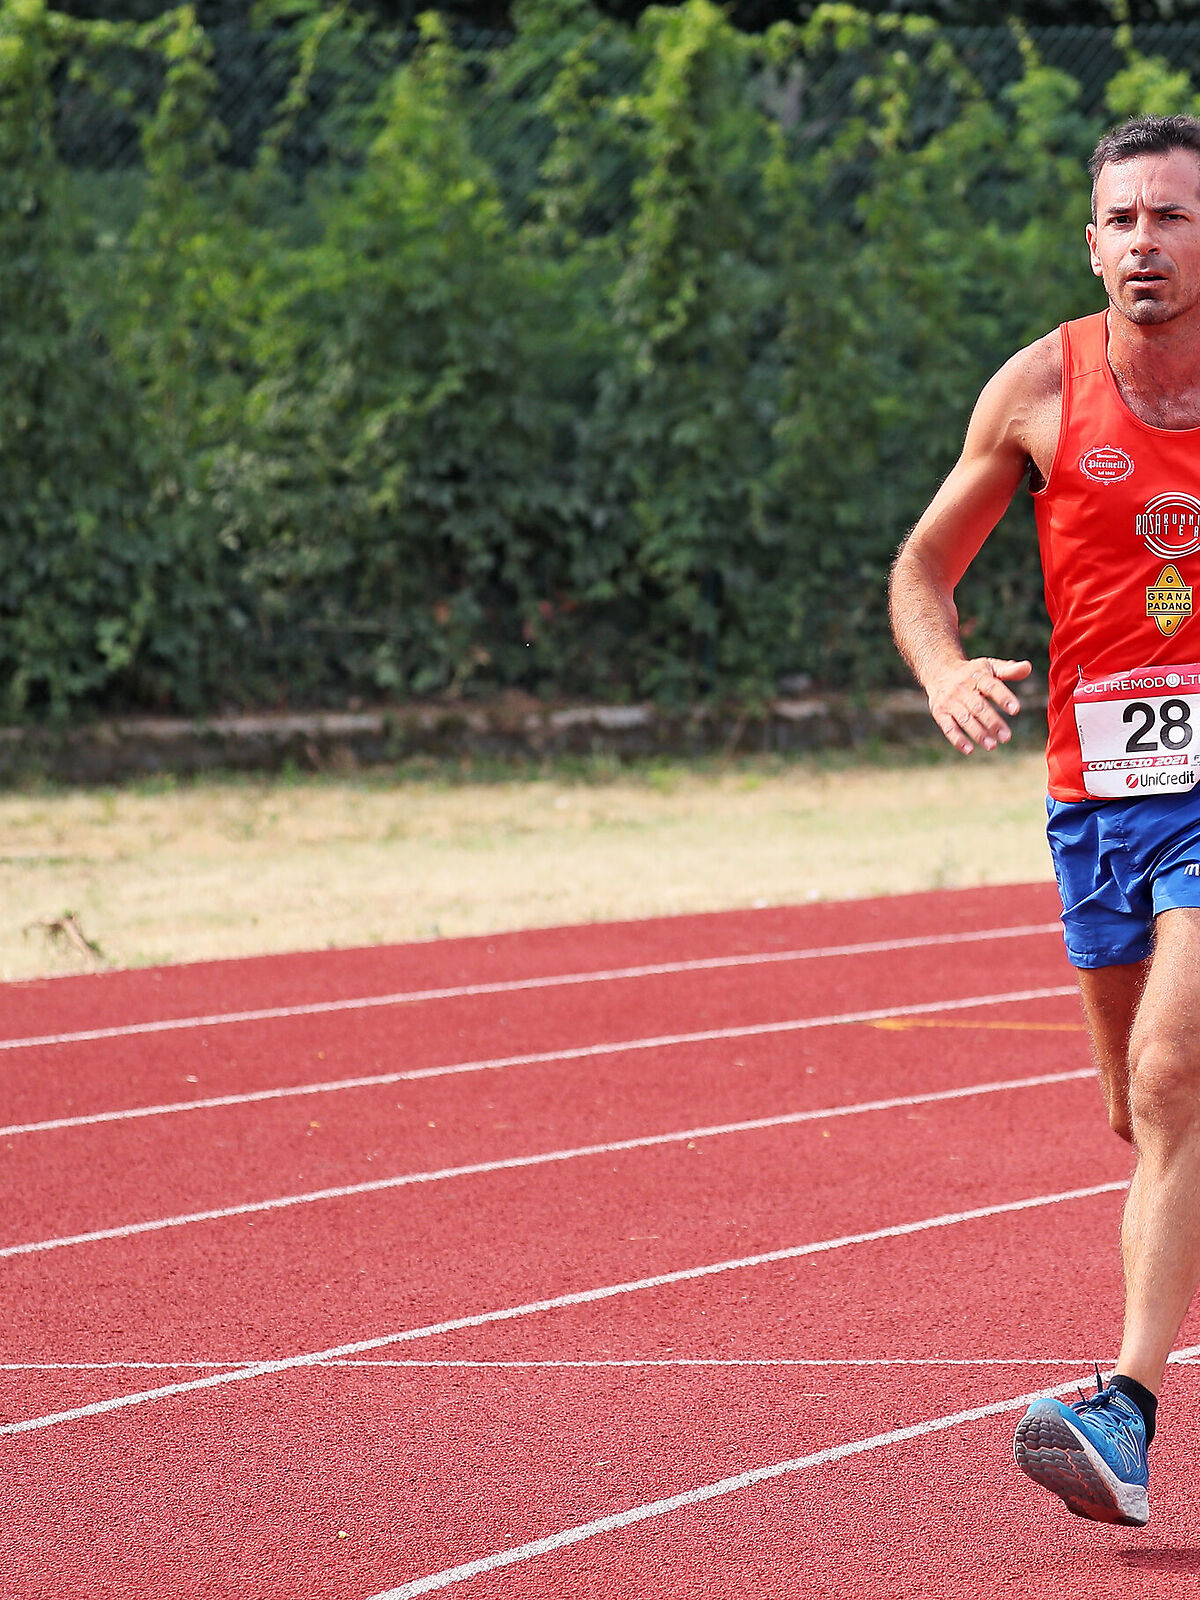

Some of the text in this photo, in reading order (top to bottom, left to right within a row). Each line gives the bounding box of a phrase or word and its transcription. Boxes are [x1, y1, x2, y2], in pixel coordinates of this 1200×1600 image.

[1087, 459, 1127, 469] Piccinelli
[1135, 513, 1161, 535] ROSA
[1166, 576, 1174, 584] G
[1147, 592, 1191, 601] GRANA
[1147, 602, 1191, 610] PADANO
[1166, 619, 1172, 628] P
[1122, 698, 1193, 753] 28
[1087, 757, 1152, 771] CONCESIO
[1154, 754, 1187, 767] 2021
[1140, 770, 1195, 788] UniCredit
